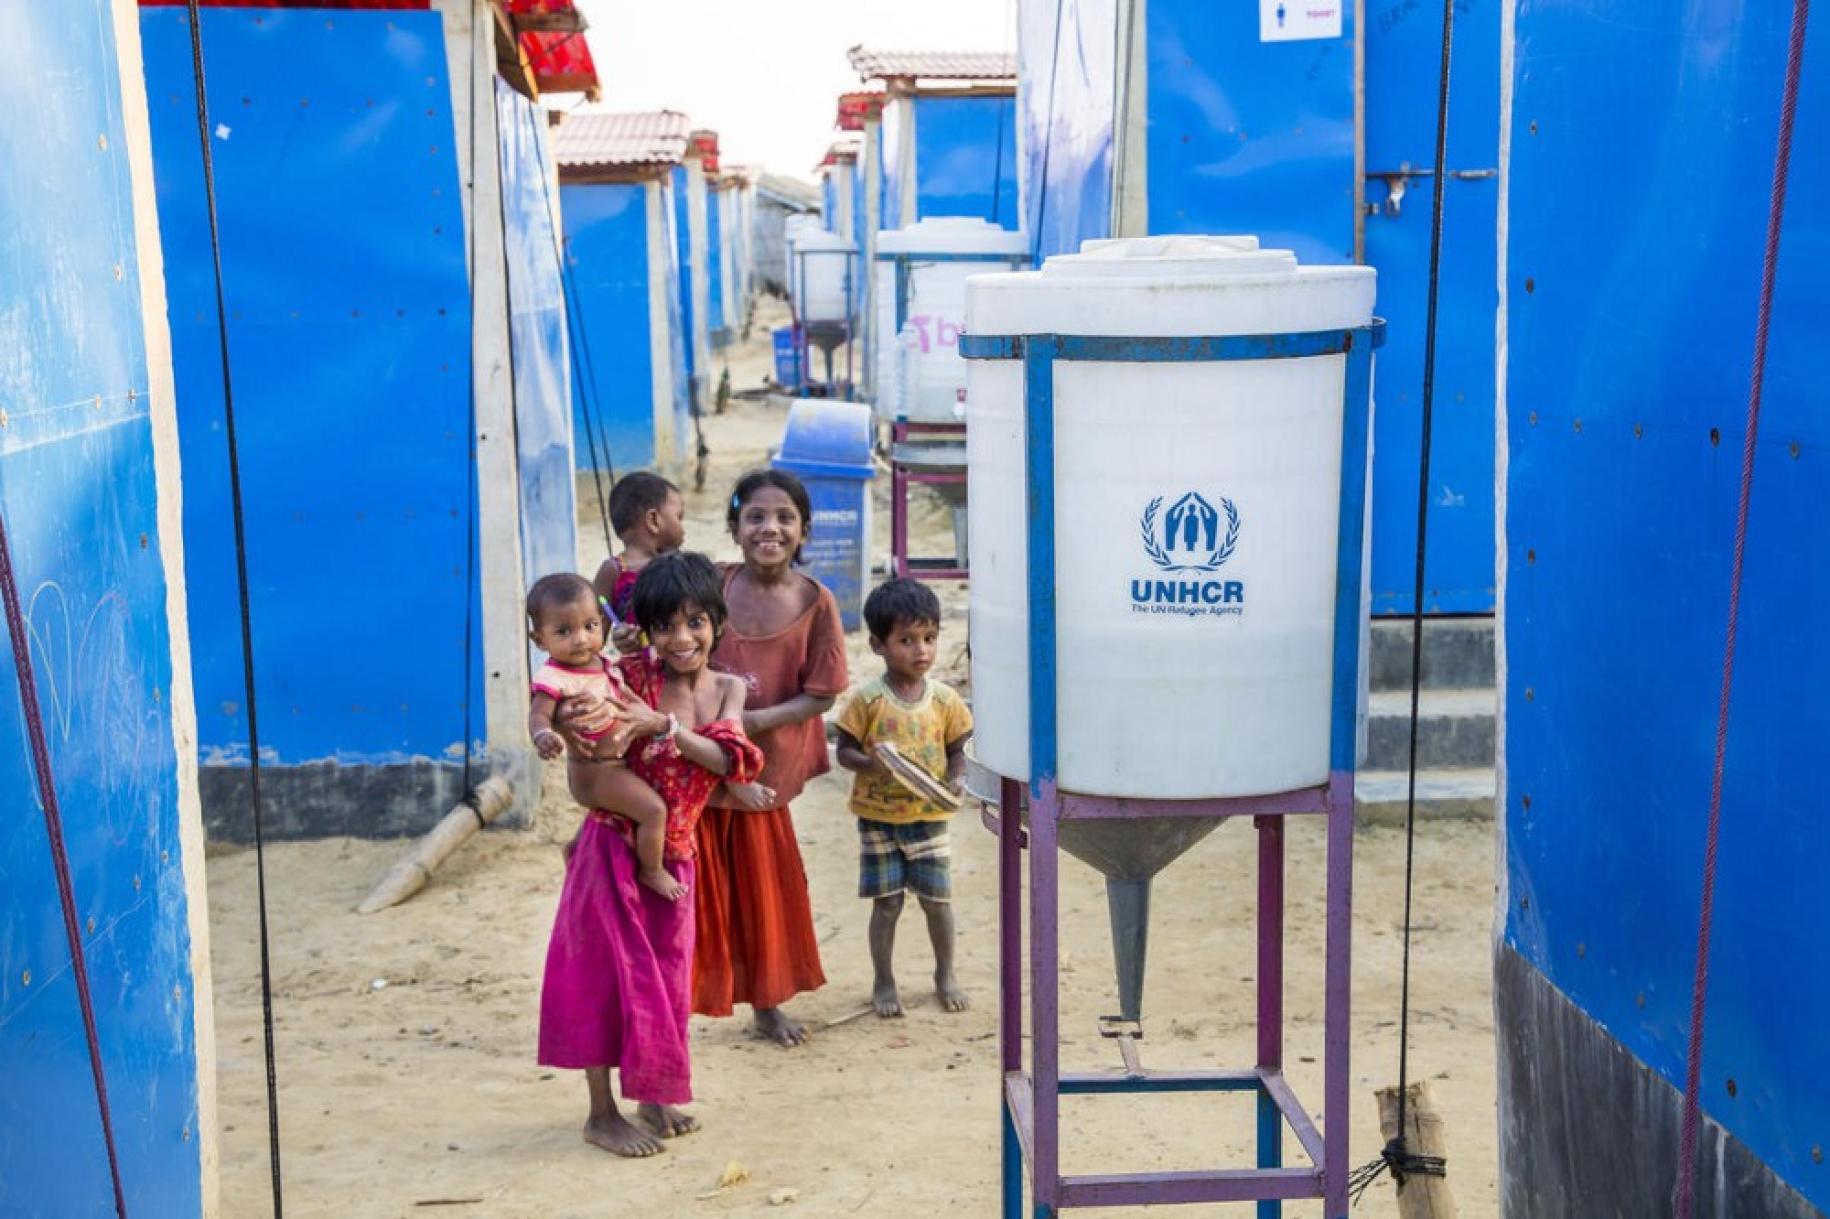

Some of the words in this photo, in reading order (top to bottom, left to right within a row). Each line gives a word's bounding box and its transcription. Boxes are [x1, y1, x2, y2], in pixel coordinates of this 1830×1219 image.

[1132, 580, 1244, 603] UNHCR
[1132, 604, 1149, 614] The
[1150, 605, 1166, 614] UN
[1167, 605, 1207, 617] Refugee
[1209, 606, 1244, 617] Agency
